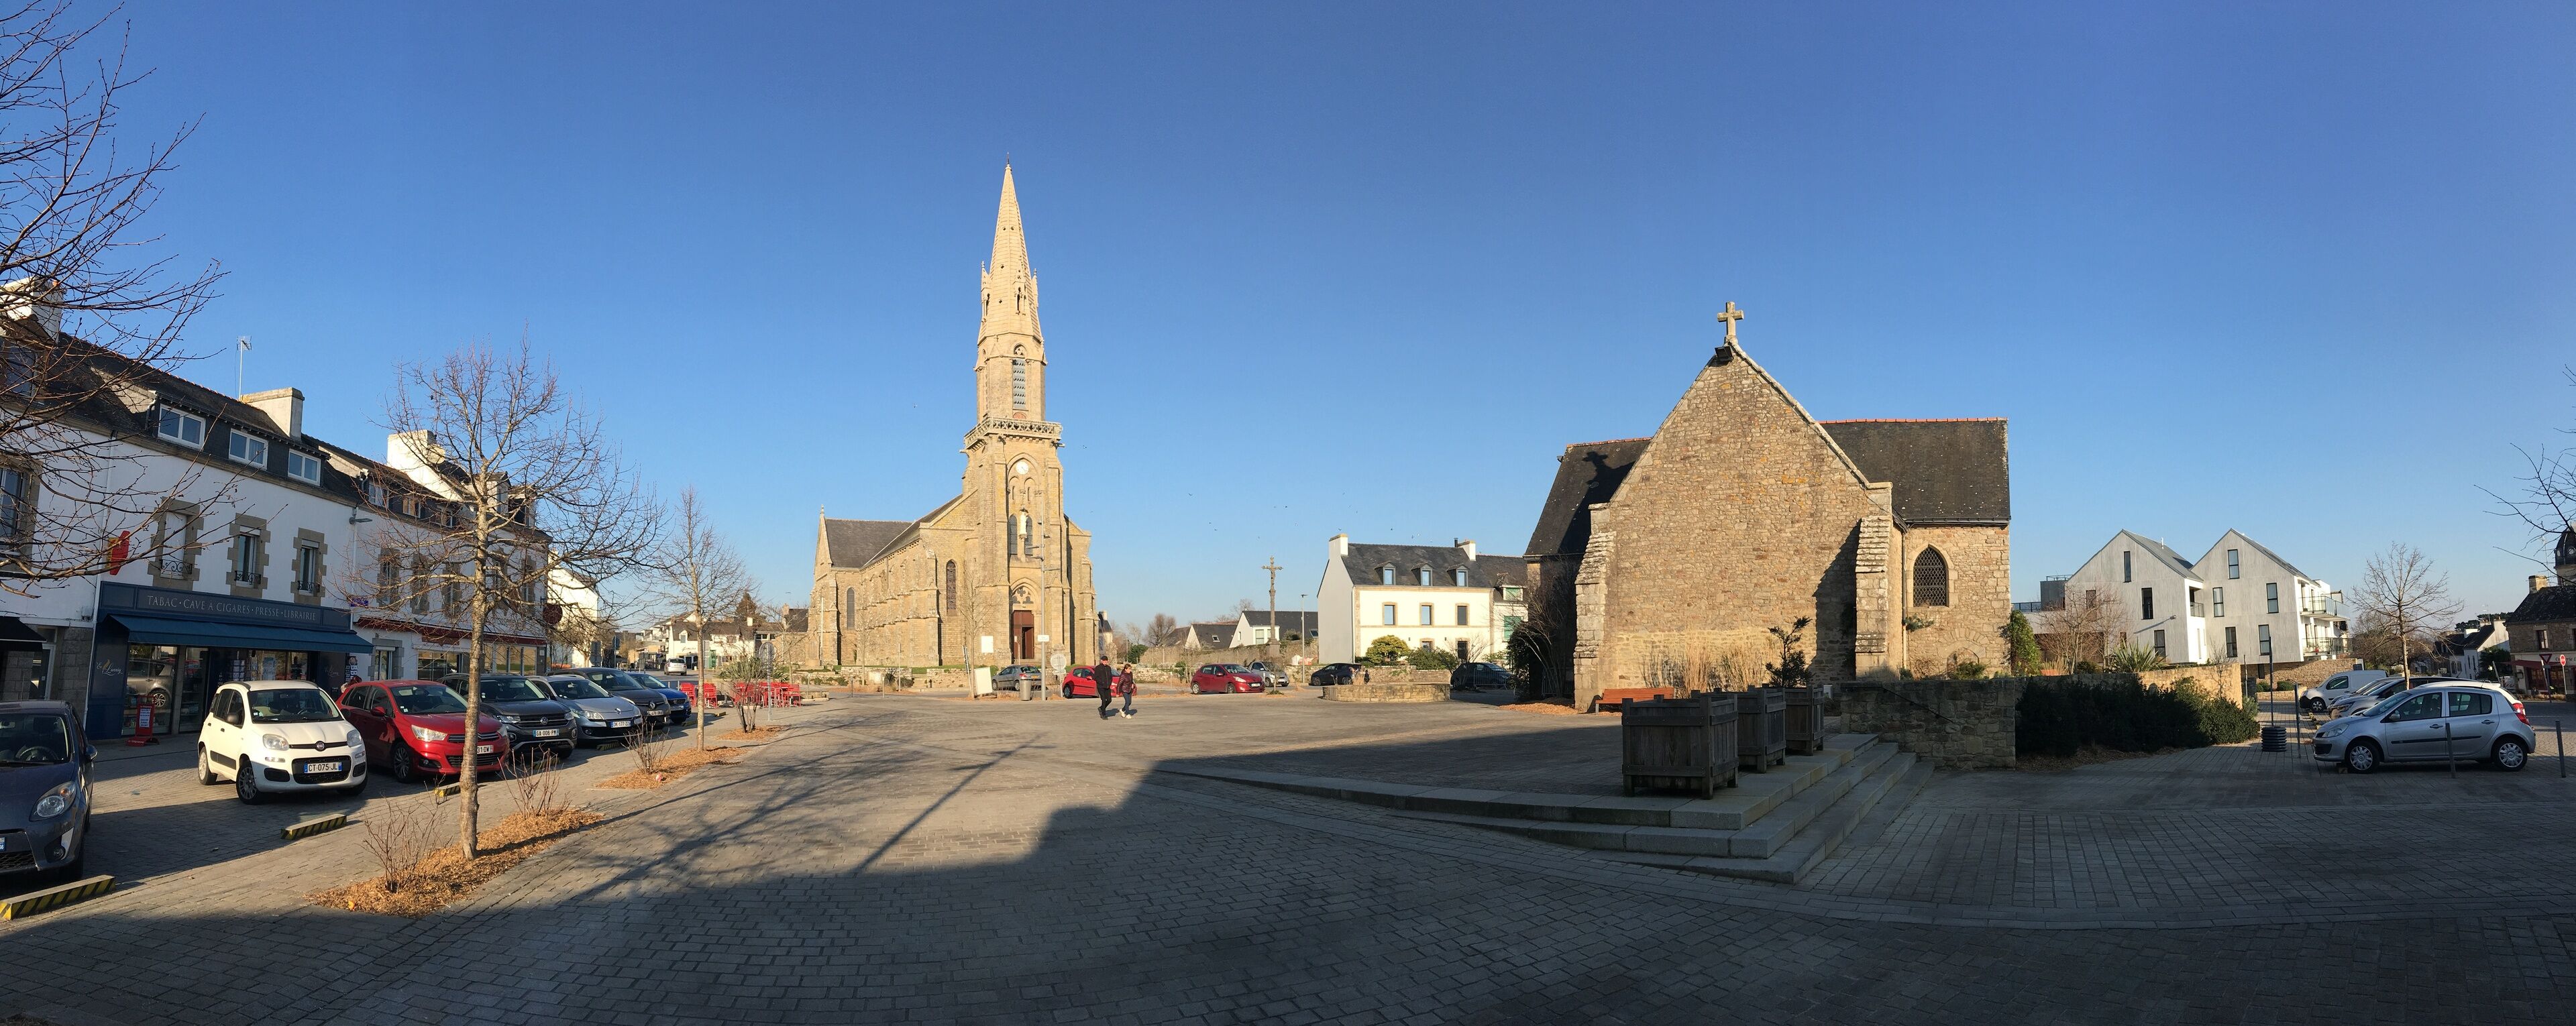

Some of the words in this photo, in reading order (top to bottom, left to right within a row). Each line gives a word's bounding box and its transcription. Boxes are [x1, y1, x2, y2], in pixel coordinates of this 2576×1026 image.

[147, 595, 178, 608] TABAC
[183, 599, 206, 610] CAVE
[216, 602, 250, 614] CIGARES
[255, 606, 279, 617] PRESSE
[284, 610, 316, 621] LIBRAIRIE
[309, 763, 337, 771] CT-075-JL
